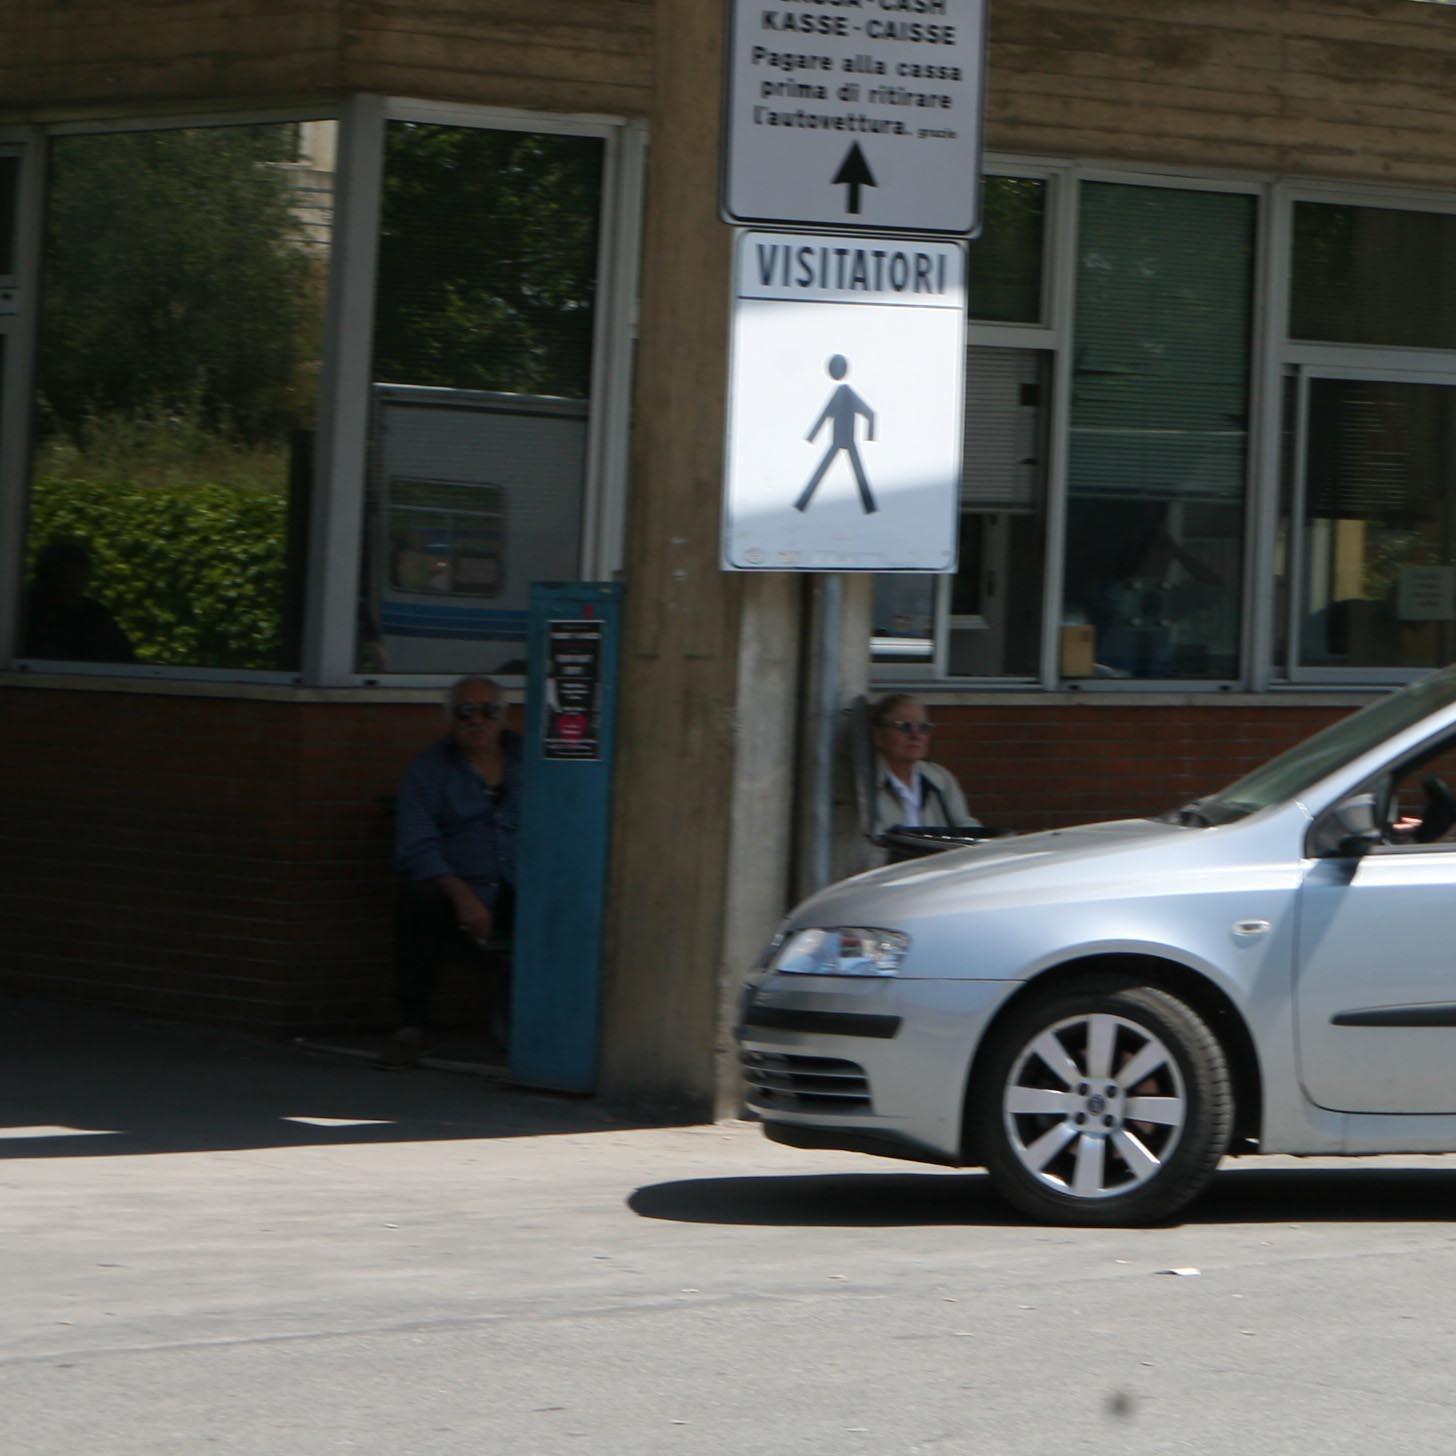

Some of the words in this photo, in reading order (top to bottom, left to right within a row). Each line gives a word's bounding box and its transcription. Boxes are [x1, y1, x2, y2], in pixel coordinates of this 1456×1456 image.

[752, 45, 834, 71] Pagare
[841, 54, 887, 75] alla
[896, 62, 963, 81] cassa
[760, 78, 828, 99] prima
[838, 83, 860, 102] di
[869, 85, 952, 109] ritirare
[757, 244, 948, 294] VISITATORI
